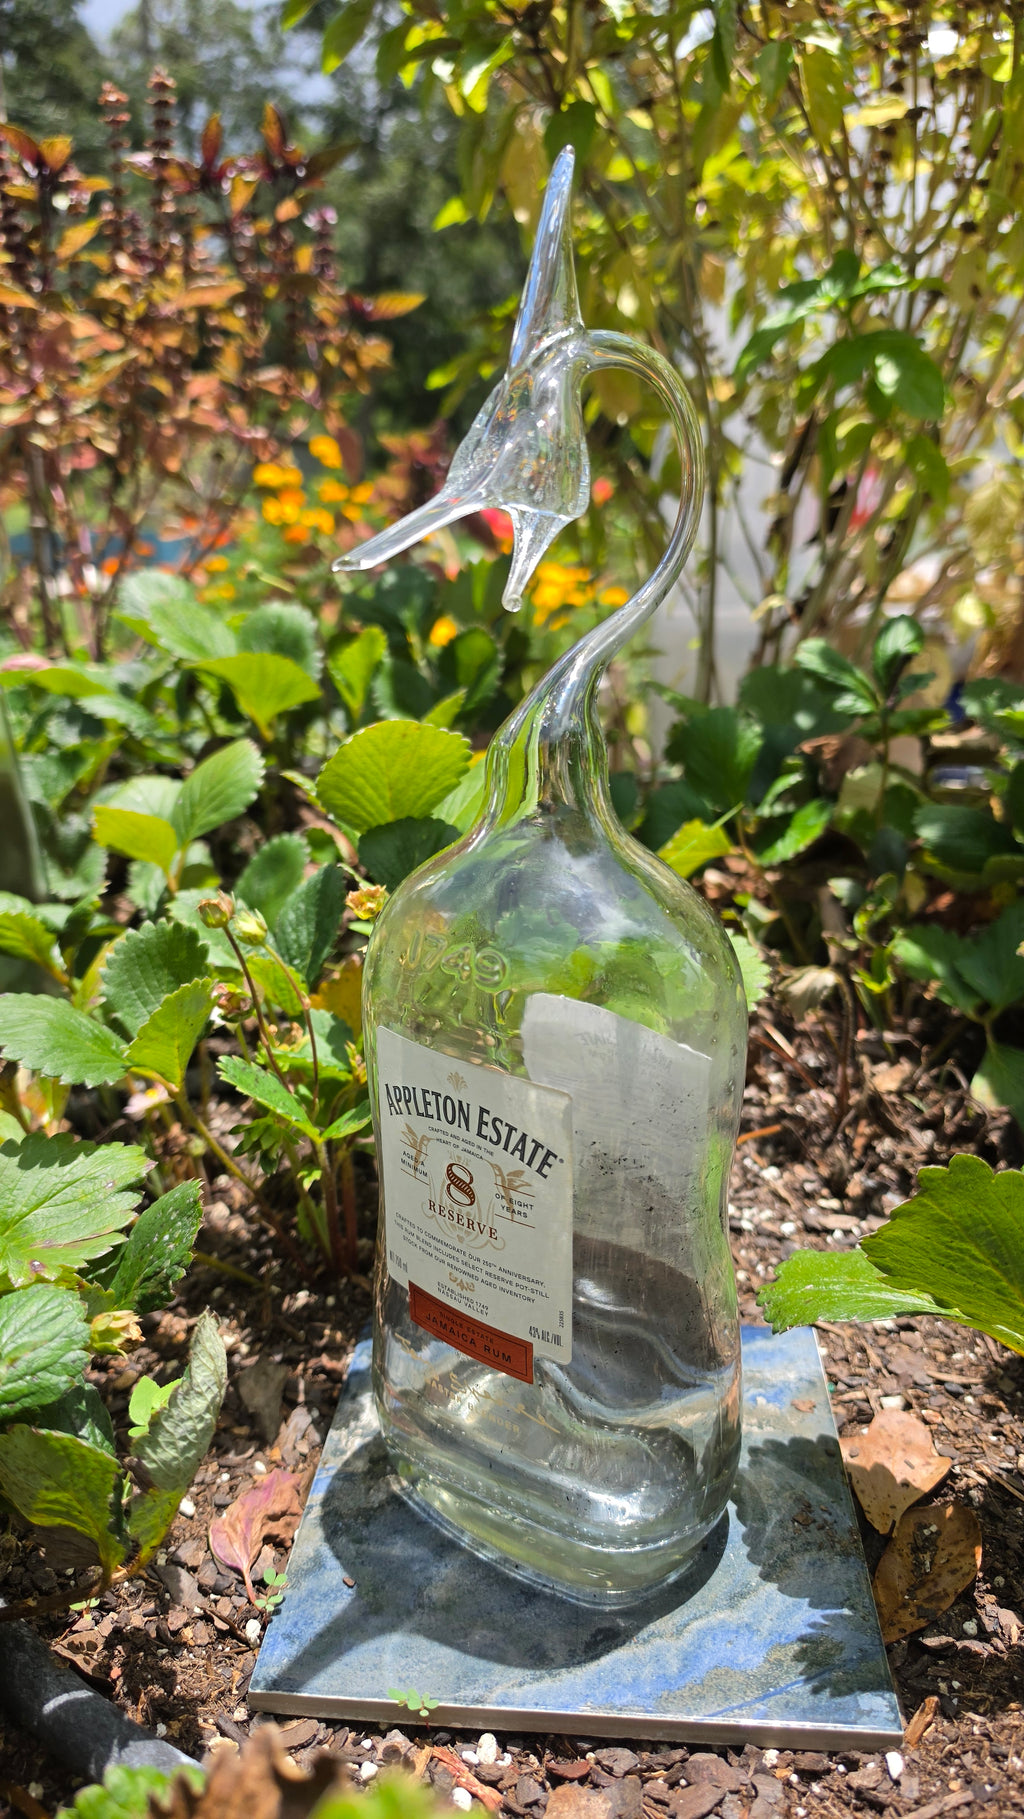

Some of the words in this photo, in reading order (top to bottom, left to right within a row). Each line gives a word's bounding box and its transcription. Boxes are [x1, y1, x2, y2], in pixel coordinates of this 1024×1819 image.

[408, 930, 507, 991] 1749
[385, 1084, 470, 1132] APPLETON
[402, 1151, 419, 1163] AGED
[428, 1126, 449, 1137] CRAFTED
[483, 1147, 494, 1157] THE
[461, 1147, 484, 1160] JAMAICA
[400, 1158, 428, 1177] MINIMUM
[445, 1163, 476, 1208] 8
[495, 1193, 505, 1201] OF
[509, 1198, 534, 1211] EIGHT
[501, 1204, 528, 1219] YEARS
[428, 1199, 498, 1241] RESERVE
[417, 1226, 424, 1234] TO
[424, 1231, 467, 1257] COMMEMORATE
[468, 1253, 481, 1263] OUR
[419, 1245, 434, 1259] FROM
[447, 1261, 479, 1282] RENOWNED
[481, 1278, 498, 1290] AGED
[499, 1286, 536, 1304] INVENTORY
[433, 1245, 460, 1263] INCLUDES
[461, 1259, 483, 1274] SELECT
[485, 1270, 513, 1287] RESERVE
[515, 1282, 550, 1299] POT-STILL
[437, 1281, 475, 1304] ESTABLISHED
[437, 1287, 462, 1304] NASSAU
[464, 1301, 489, 1317] VALLEY
[425, 1313, 477, 1348] JAMAICA
[483, 1344, 512, 1364] RUM
[466, 1326, 494, 1344] ESTATE
